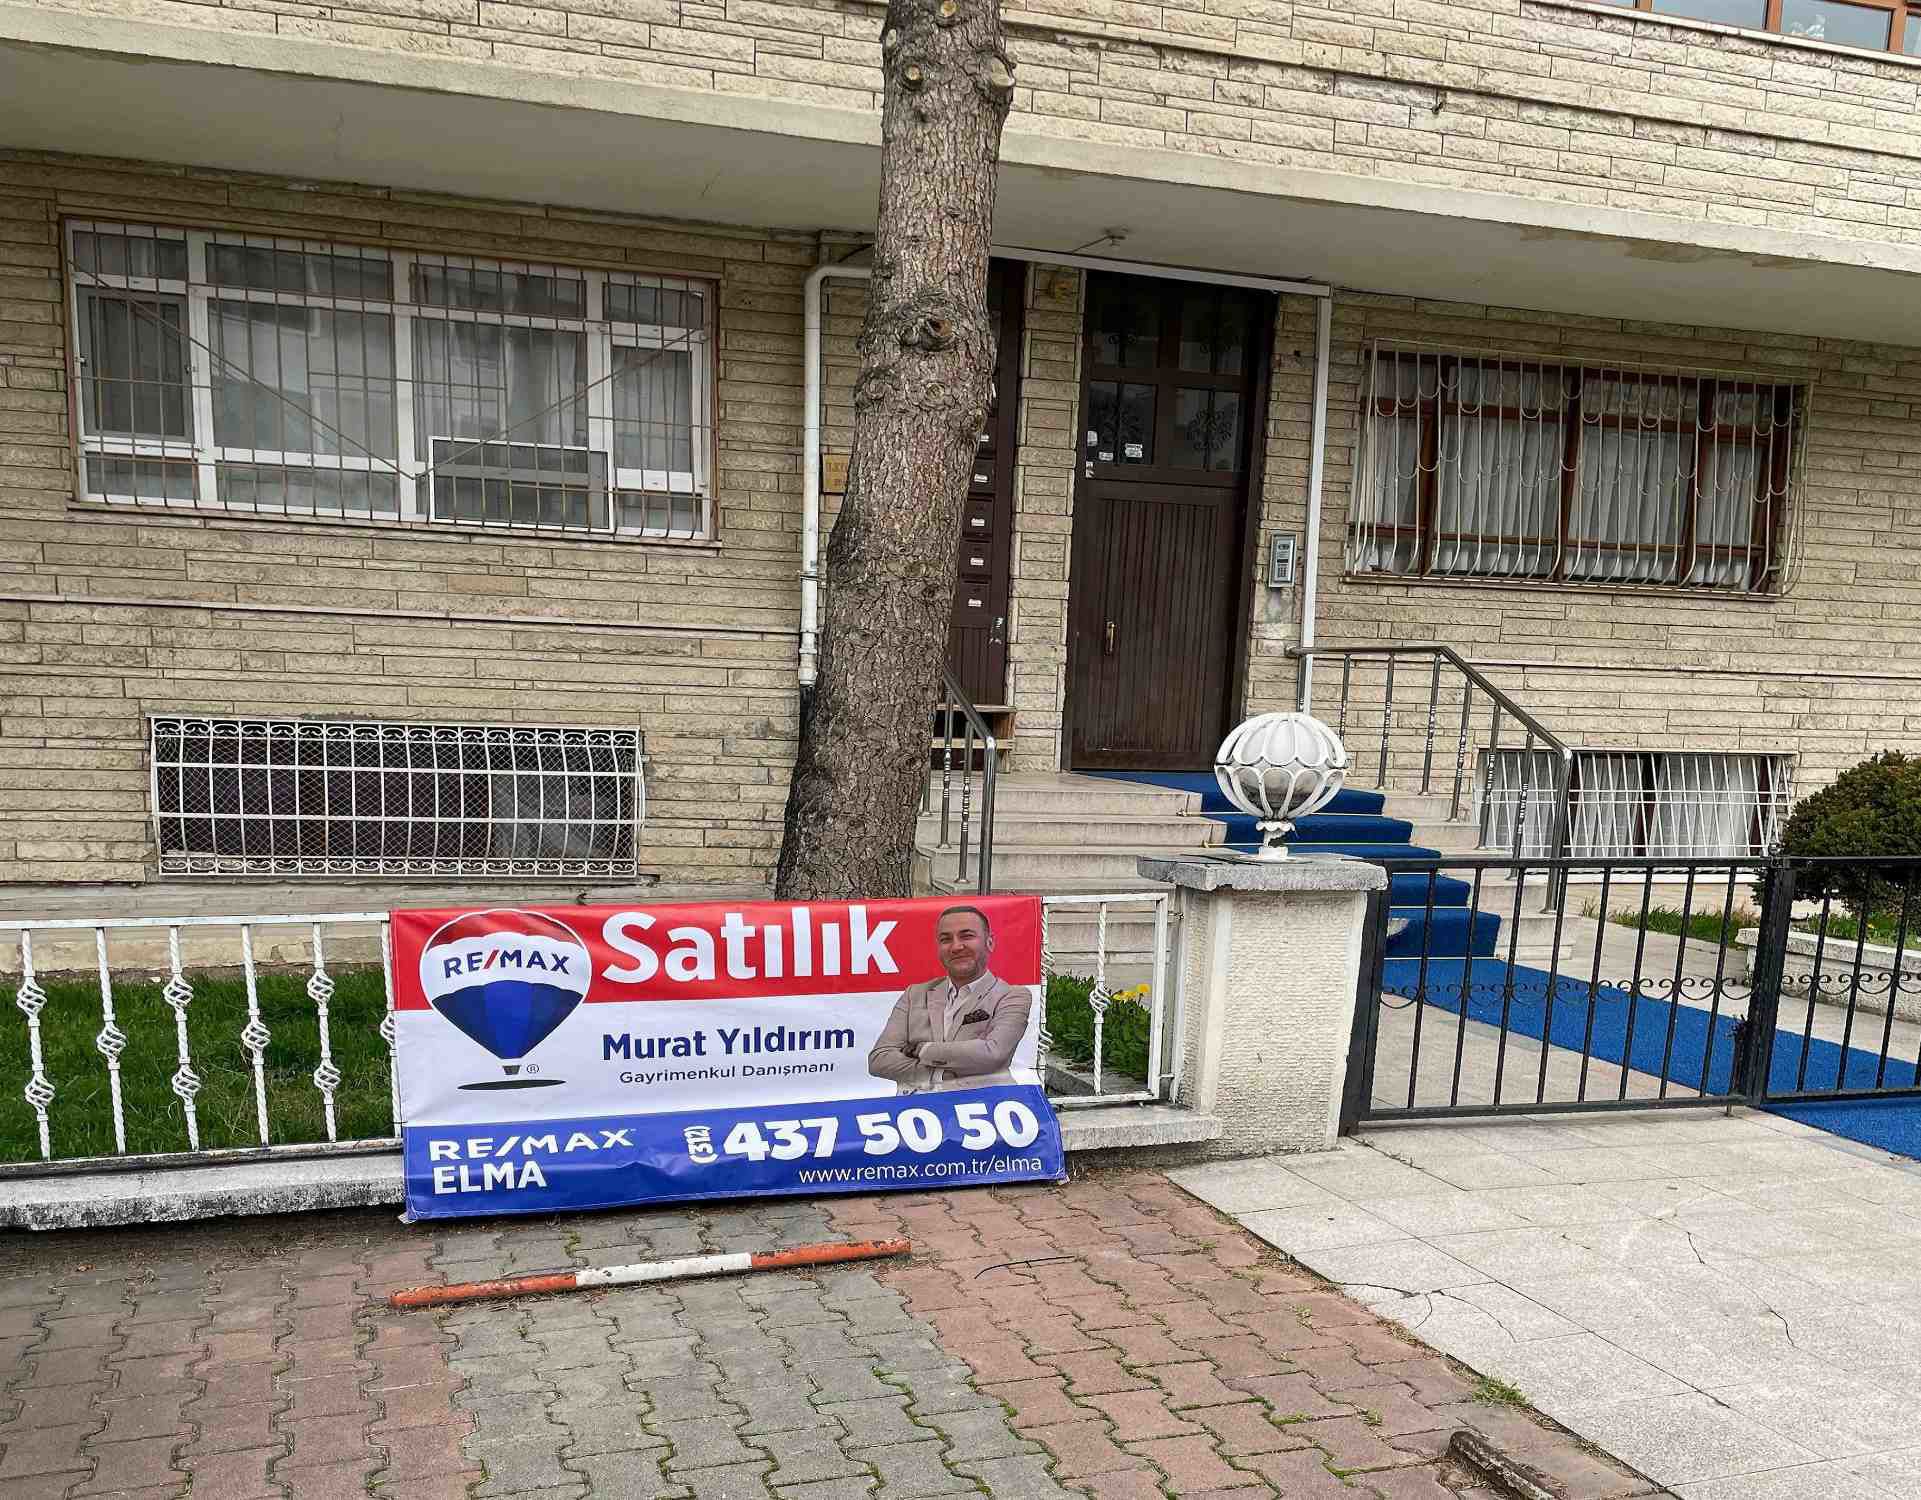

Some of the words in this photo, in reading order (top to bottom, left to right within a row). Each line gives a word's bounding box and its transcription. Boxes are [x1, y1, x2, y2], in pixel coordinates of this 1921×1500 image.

[602, 905, 899, 984] Satılık
[443, 949, 570, 979] RE/MAX
[603, 1030, 706, 1060] Murat
[717, 1026, 856, 1055] Yıldırım
[619, 1066, 736, 1085] Gayrimenkul
[742, 1062, 834, 1078] Danışmanı
[428, 1129, 634, 1161] RE/MAX
[723, 1117, 839, 1162] 437
[856, 1108, 943, 1155] 50
[954, 1100, 1040, 1150] 50
[432, 1160, 547, 1195] ELMA
[799, 1154, 1043, 1184] www.remax.com.tr/elma
